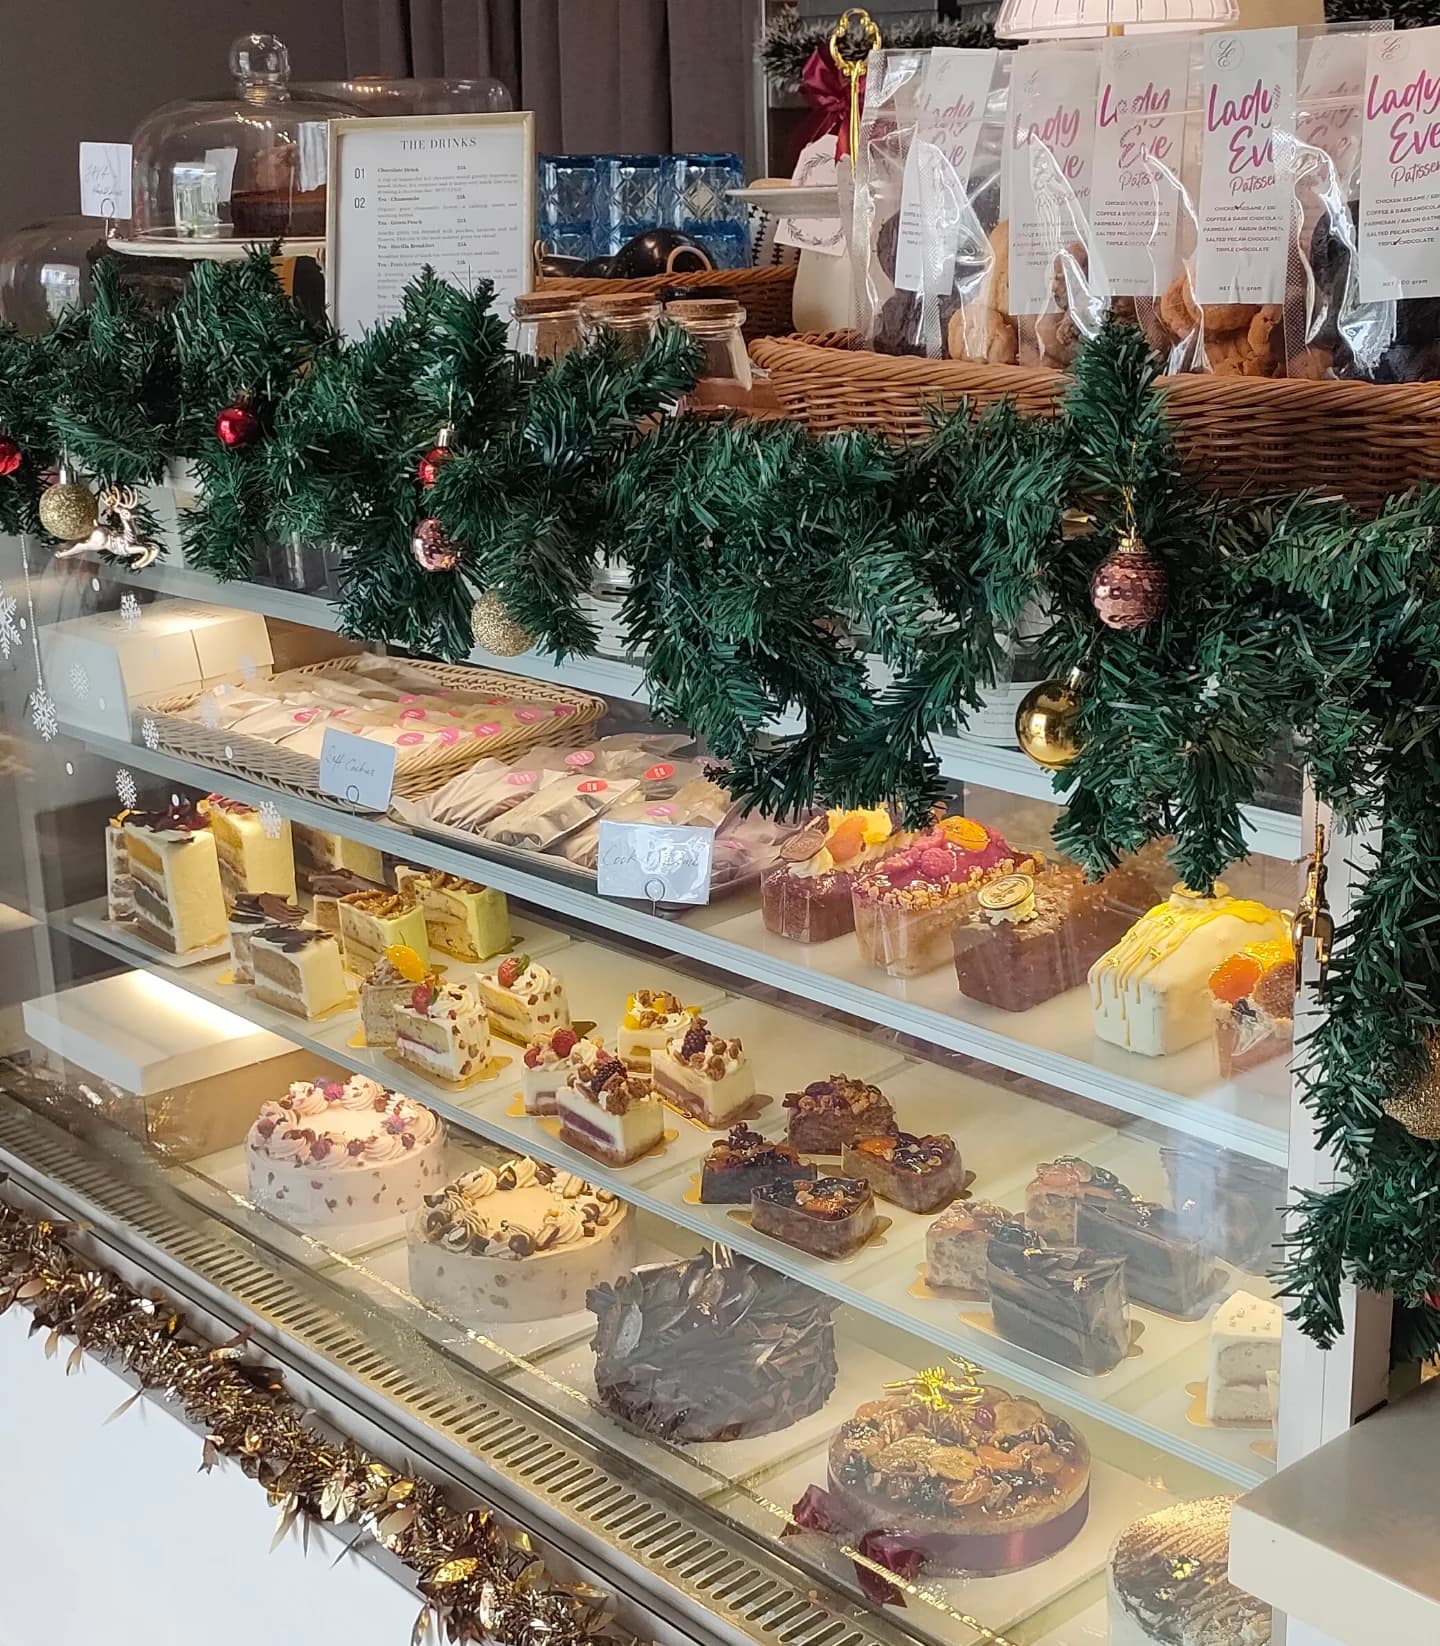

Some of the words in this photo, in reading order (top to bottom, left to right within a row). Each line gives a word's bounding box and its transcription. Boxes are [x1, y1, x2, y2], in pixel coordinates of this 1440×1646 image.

[1208, 79, 1273, 132] Lady
[1367, 69, 1440, 120] Lady
[400, 139, 426, 150] THE
[430, 137, 477, 149] DRINKS
[1389, 112, 1440, 164] Eve
[354, 168, 365, 179] 01
[354, 198, 365, 209] 02
